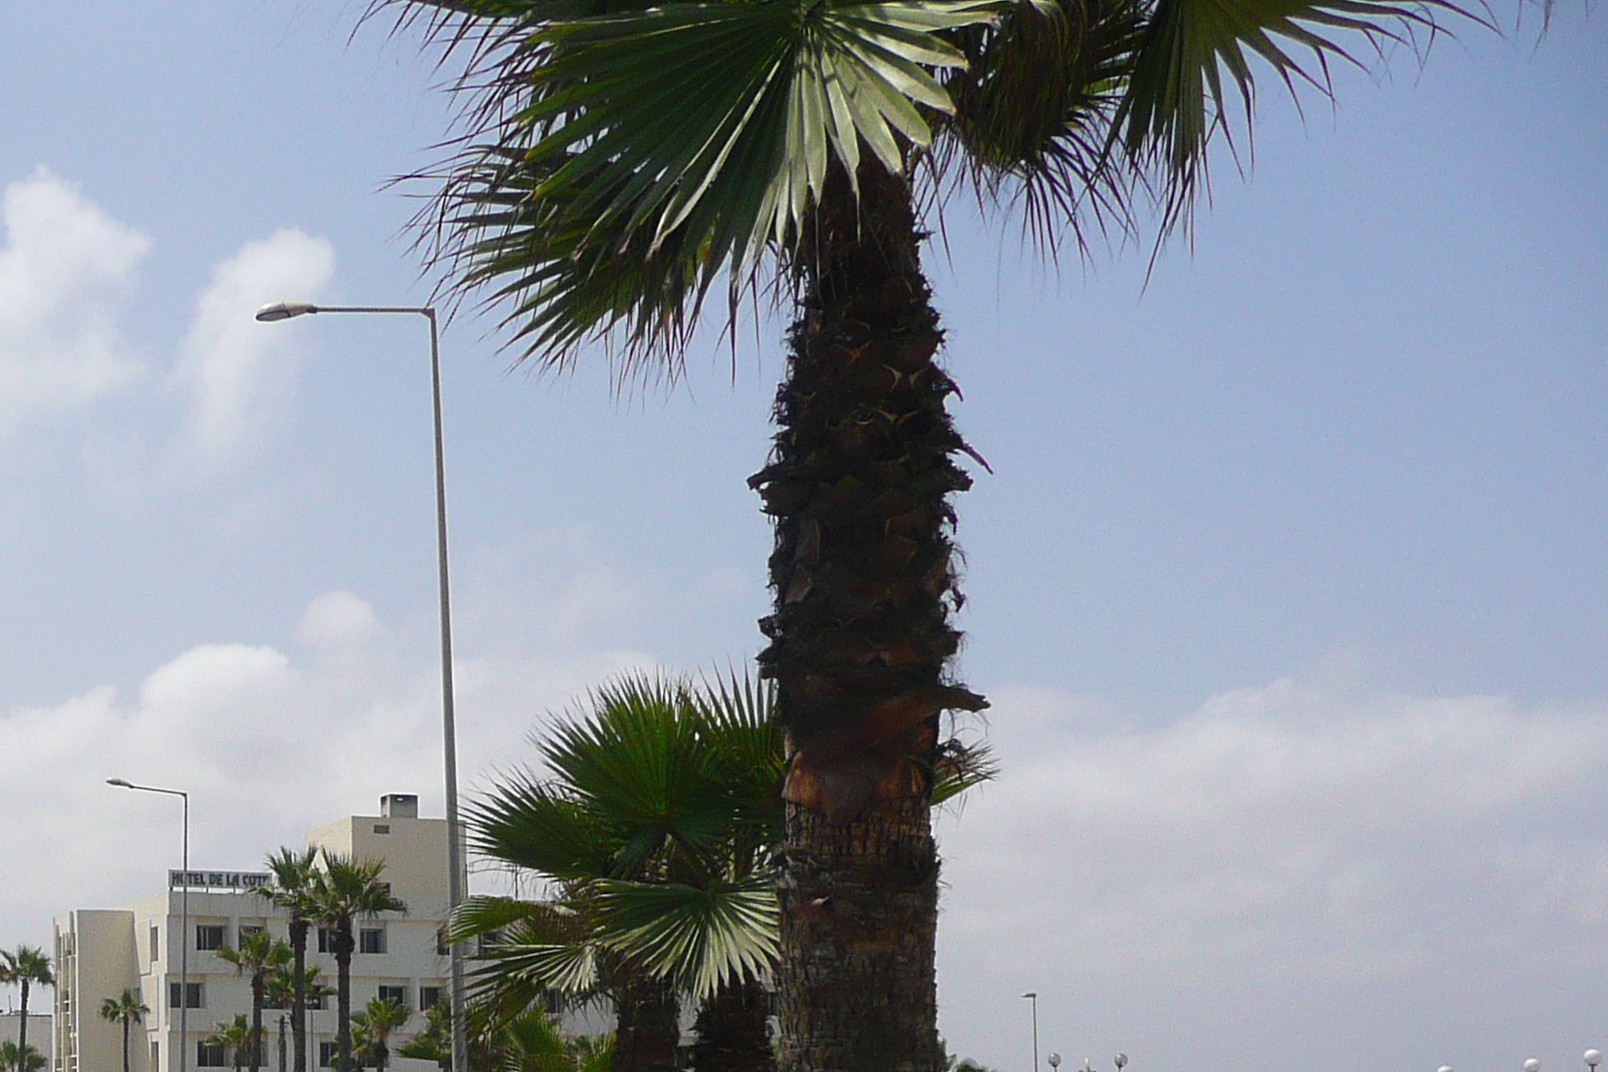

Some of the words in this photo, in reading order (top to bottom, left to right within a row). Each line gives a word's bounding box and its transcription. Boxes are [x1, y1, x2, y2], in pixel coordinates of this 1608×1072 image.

[171, 871, 206, 886] HOTEL
[209, 873, 223, 886] DE
[226, 873, 239, 887] LA
